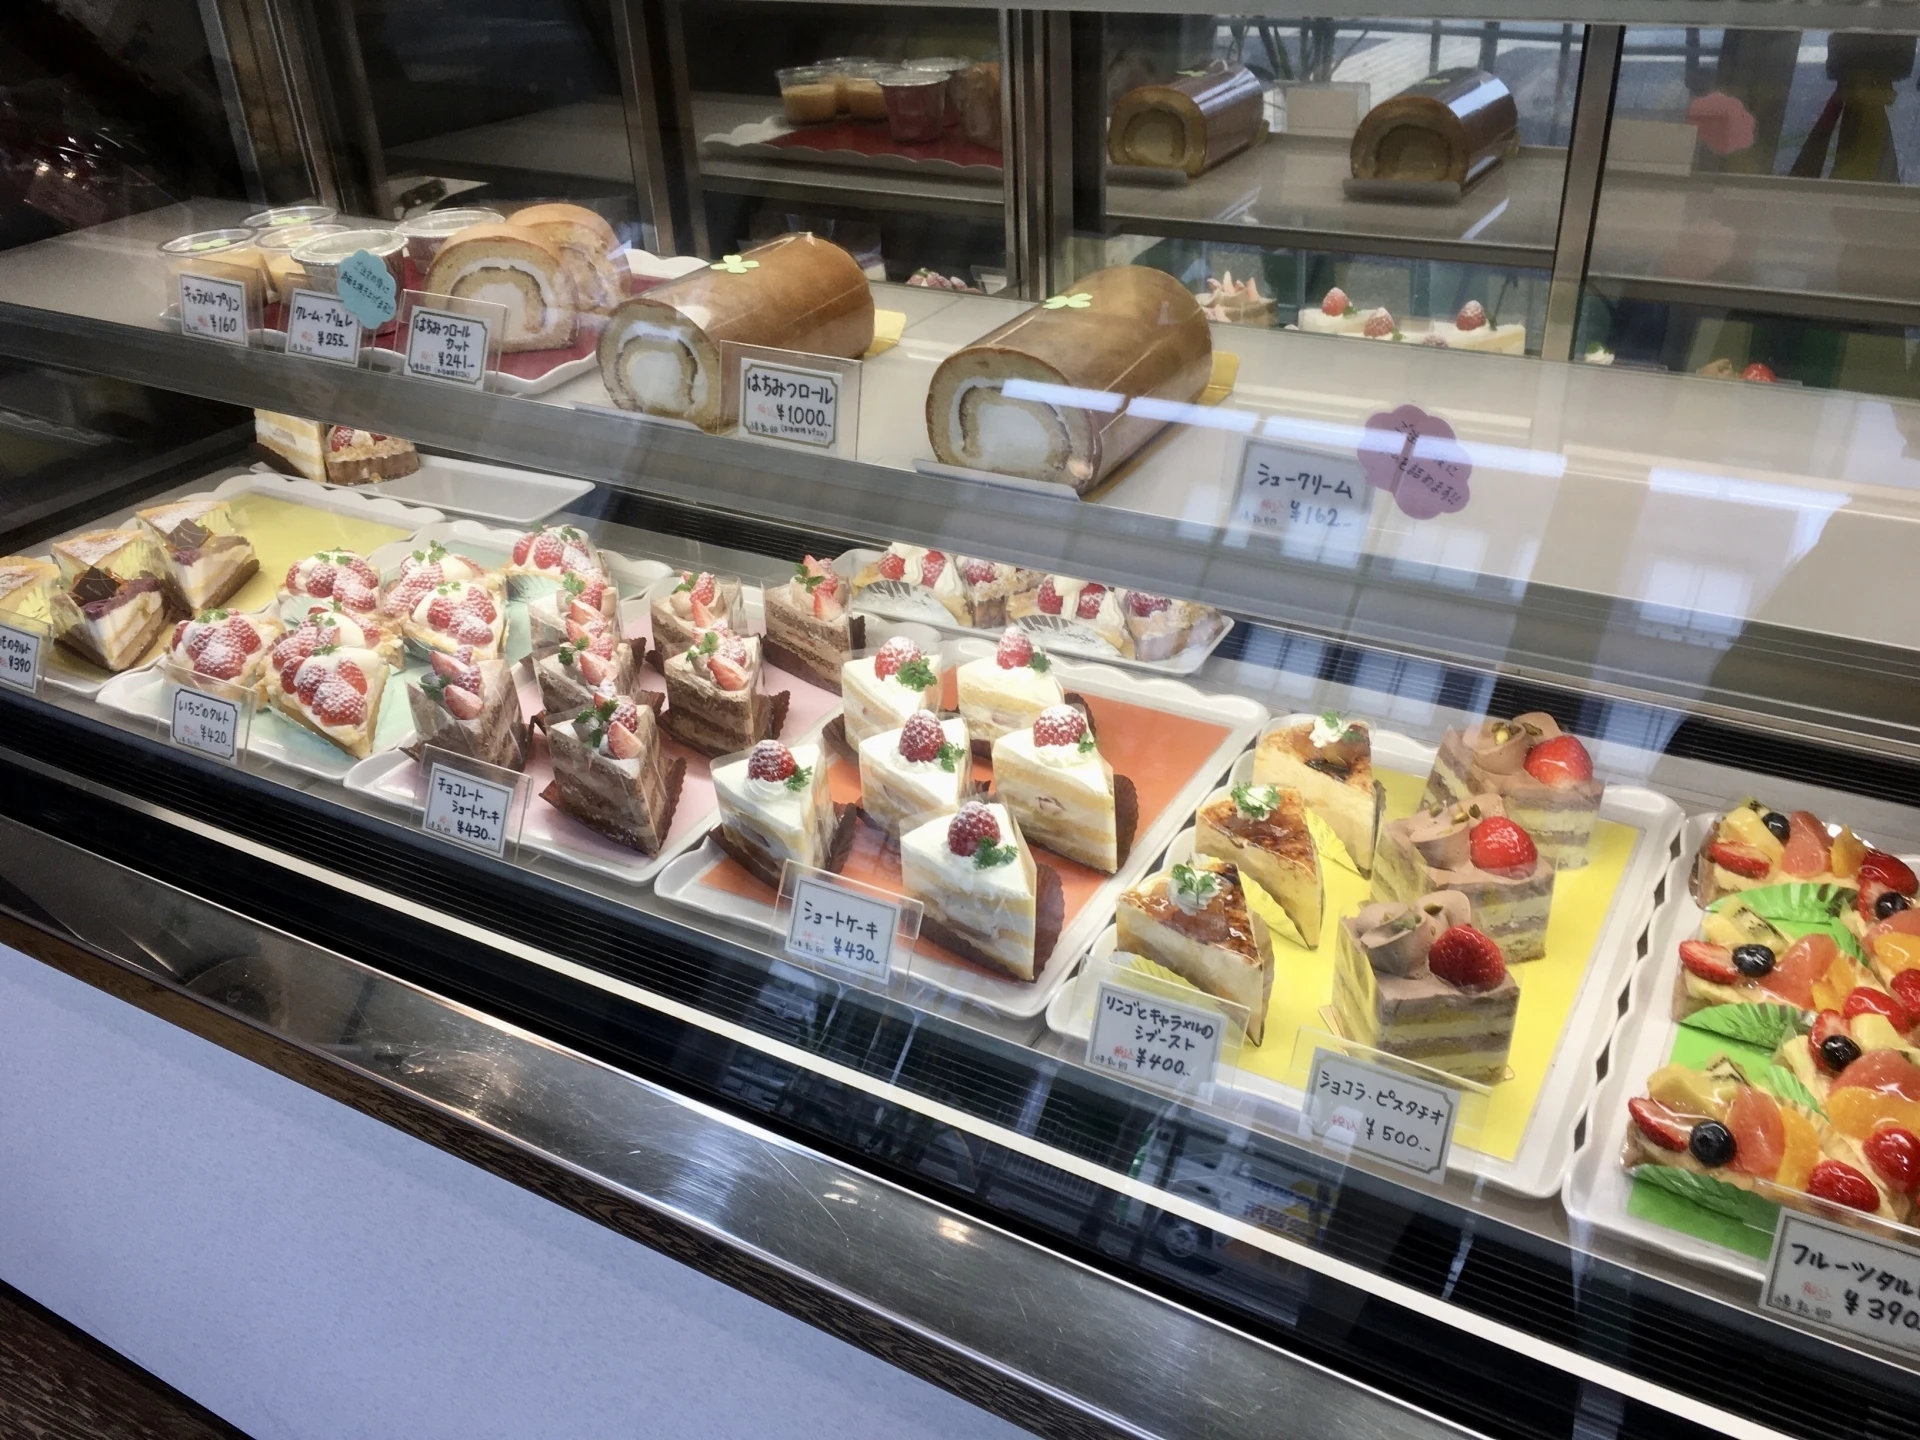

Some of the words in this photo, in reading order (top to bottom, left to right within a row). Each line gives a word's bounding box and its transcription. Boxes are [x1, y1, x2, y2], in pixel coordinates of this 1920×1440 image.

[183, 285, 240, 312] キャラメルプリン
[415, 317, 471, 338] はちみつロール
[446, 337, 470, 352] カット
[747, 373, 833, 405] はちみつロール
[1257, 462, 1353, 500] シュークリーム
[8, 655, 31, 673] ¥390
[178, 700, 229, 725] いちごのタルト
[437, 777, 484, 802] チョコレート
[451, 800, 500, 825] ショートケーキ
[804, 900, 878, 940] ショートケーキ
[1106, 995, 1214, 1040] リンゴとキャラメルの
[1135, 1025, 1196, 1051] シブースト
